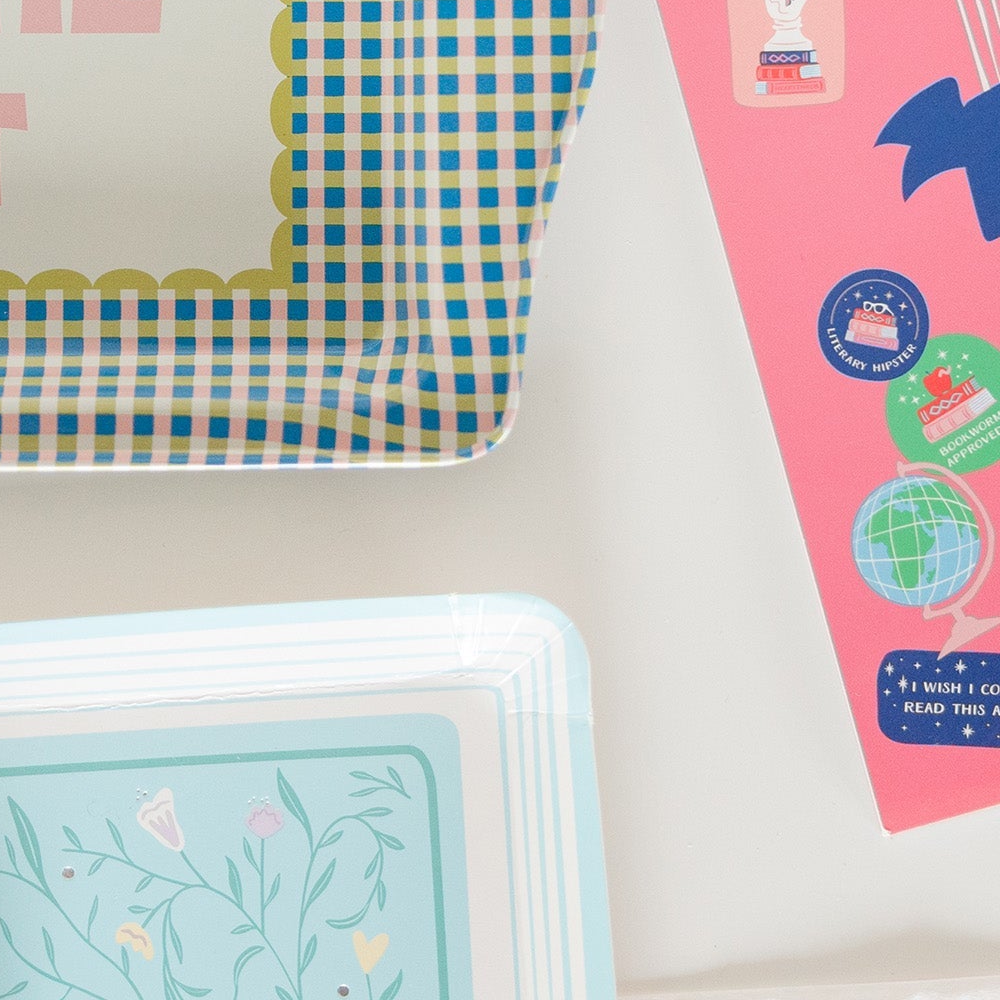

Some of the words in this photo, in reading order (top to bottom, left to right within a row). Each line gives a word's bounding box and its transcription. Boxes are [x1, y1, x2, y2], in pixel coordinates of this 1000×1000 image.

[826, 327, 868, 371] LITERARY
[872, 343, 917, 373] HIPSTER
[911, 681, 917, 693] I
[923, 681, 962, 694] WISH
[969, 683, 974, 695] I
[903, 701, 945, 715] READ
[952, 703, 986, 717] THIS
